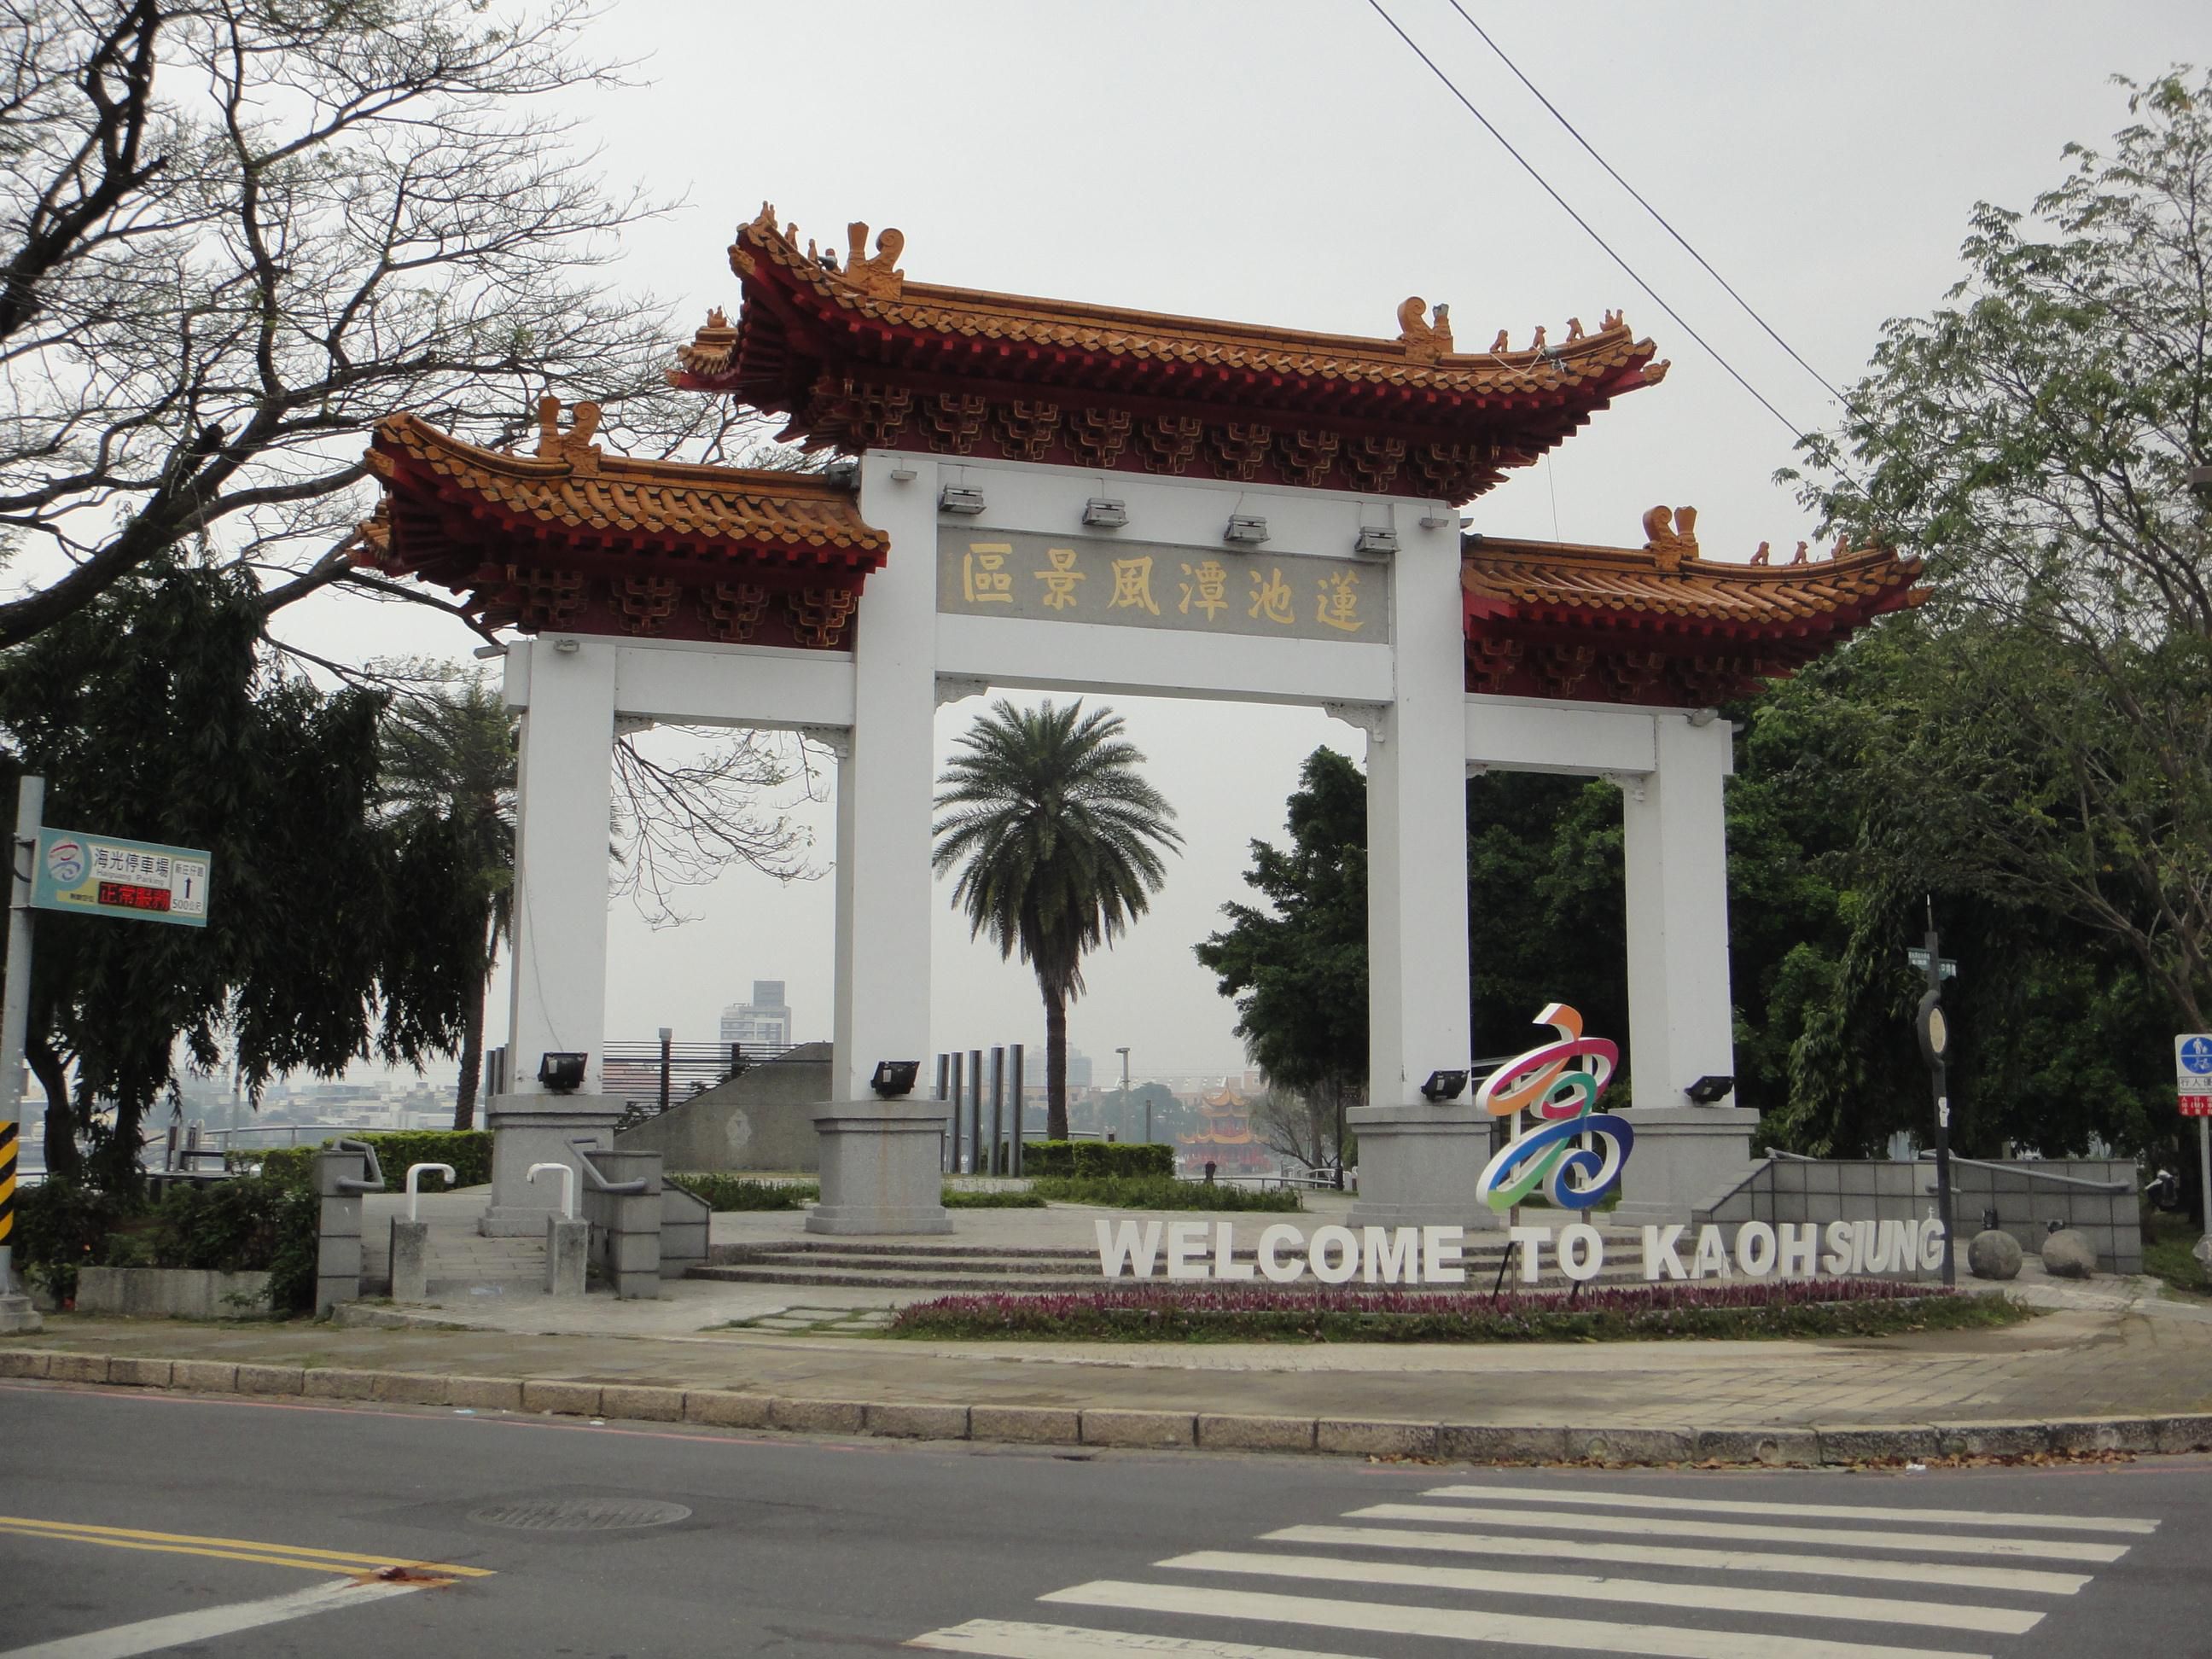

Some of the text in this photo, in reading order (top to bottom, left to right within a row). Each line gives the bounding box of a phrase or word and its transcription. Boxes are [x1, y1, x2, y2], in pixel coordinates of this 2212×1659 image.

[95, 847, 169, 879] 海光停車場
[137, 874, 165, 887] Parking
[172, 899, 202, 911] 500公尺
[1095, 1219, 1946, 1284] WELCOME TO KAOHSIUNG
